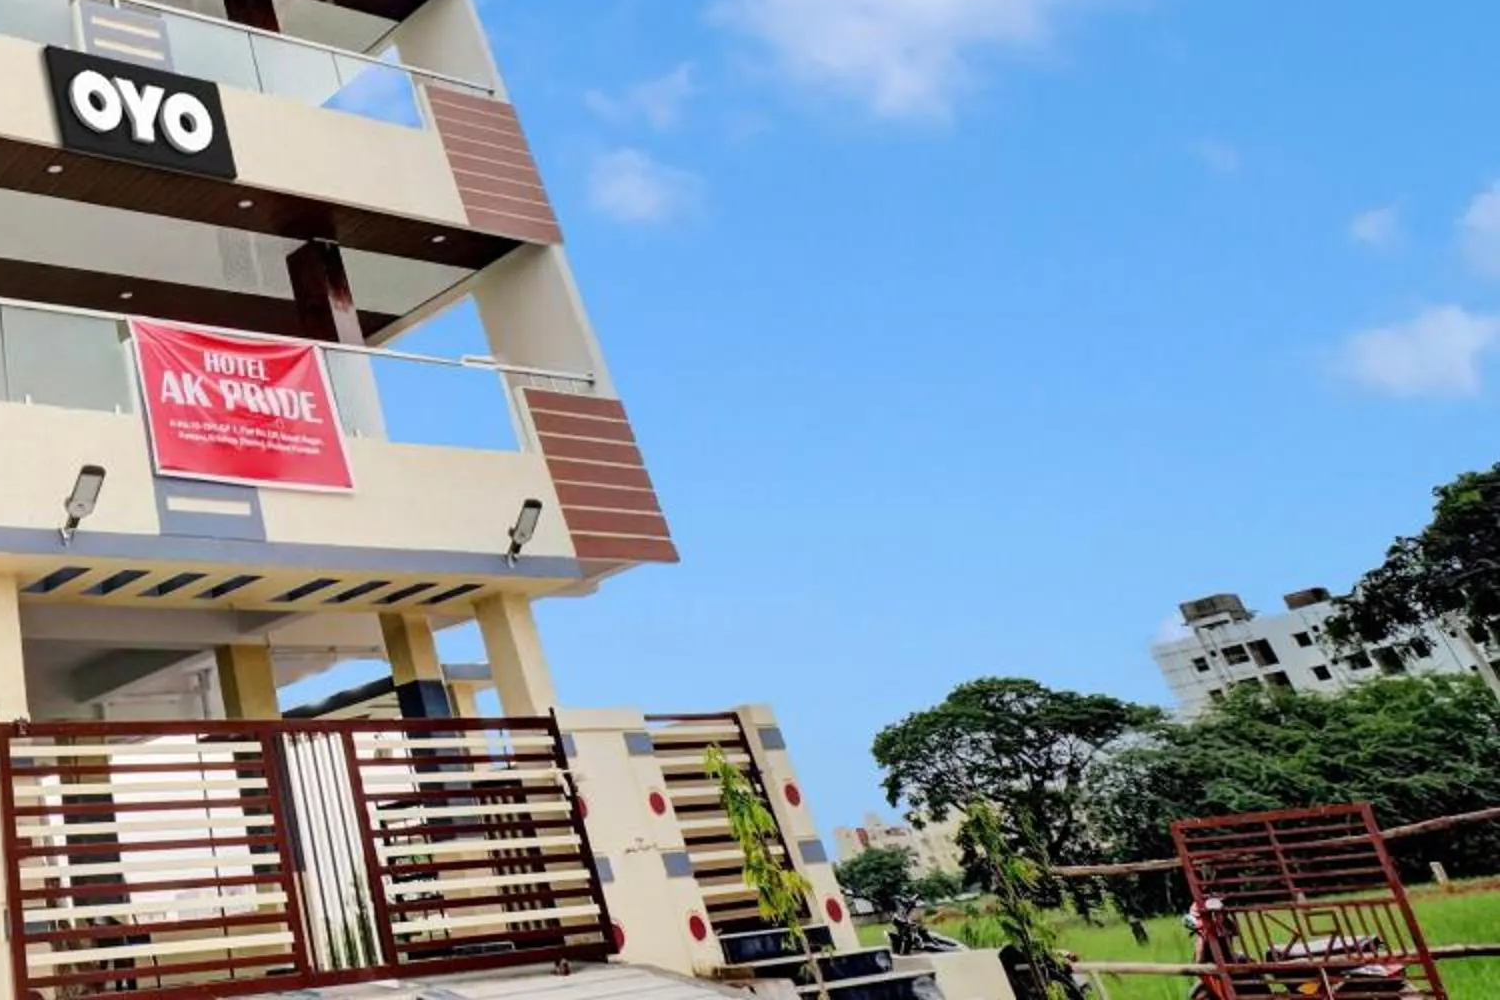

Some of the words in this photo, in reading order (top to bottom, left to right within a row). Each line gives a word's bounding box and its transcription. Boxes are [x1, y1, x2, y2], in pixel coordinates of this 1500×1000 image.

[69, 70, 213, 155] OYO
[203, 351, 270, 381] HOTEL
[161, 370, 213, 408] AK
[219, 379, 324, 424] PRIDE
